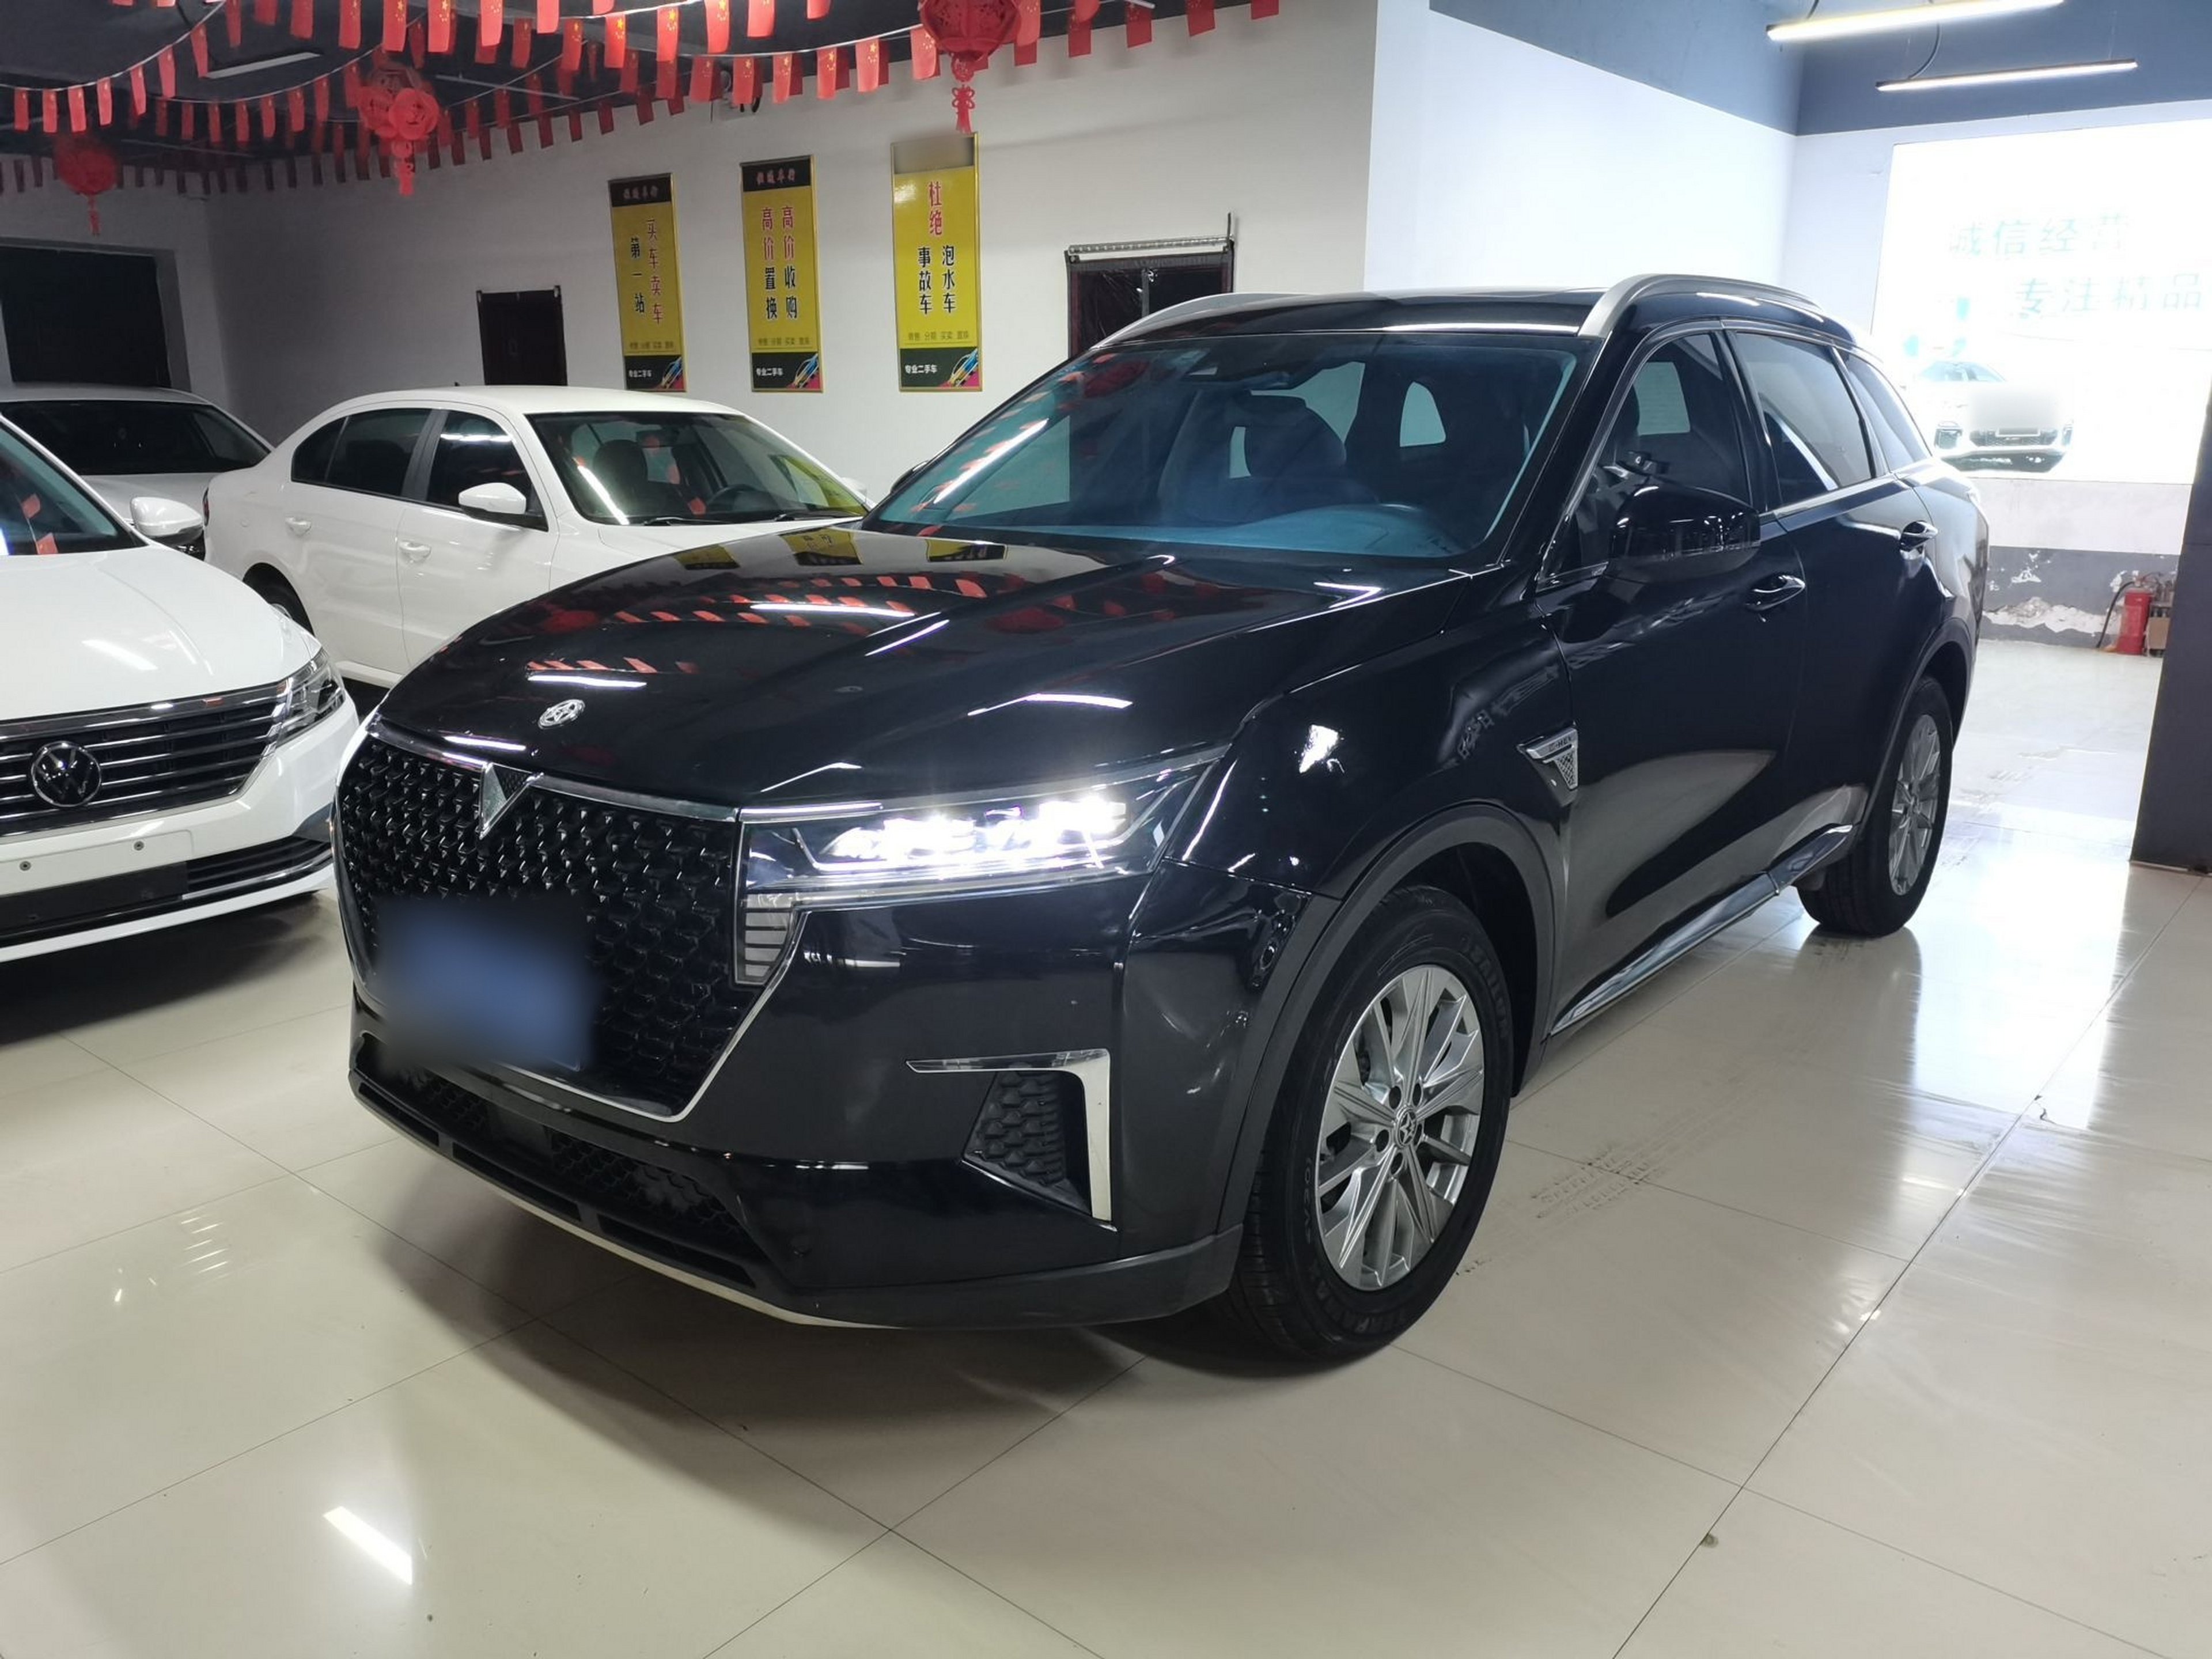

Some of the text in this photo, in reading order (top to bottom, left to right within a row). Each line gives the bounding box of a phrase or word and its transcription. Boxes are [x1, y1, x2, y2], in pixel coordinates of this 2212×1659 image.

[928, 181, 942, 236] 杜绝
[631, 237, 645, 314] 第一站
[646, 219, 663, 325] 买车卖车
[762, 207, 778, 320] 高价置换
[781, 206, 798, 320] 高价收购
[918, 247, 933, 315] 事故车
[942, 245, 956, 314] 泡水车
[905, 365, 938, 374] 专业二手车
